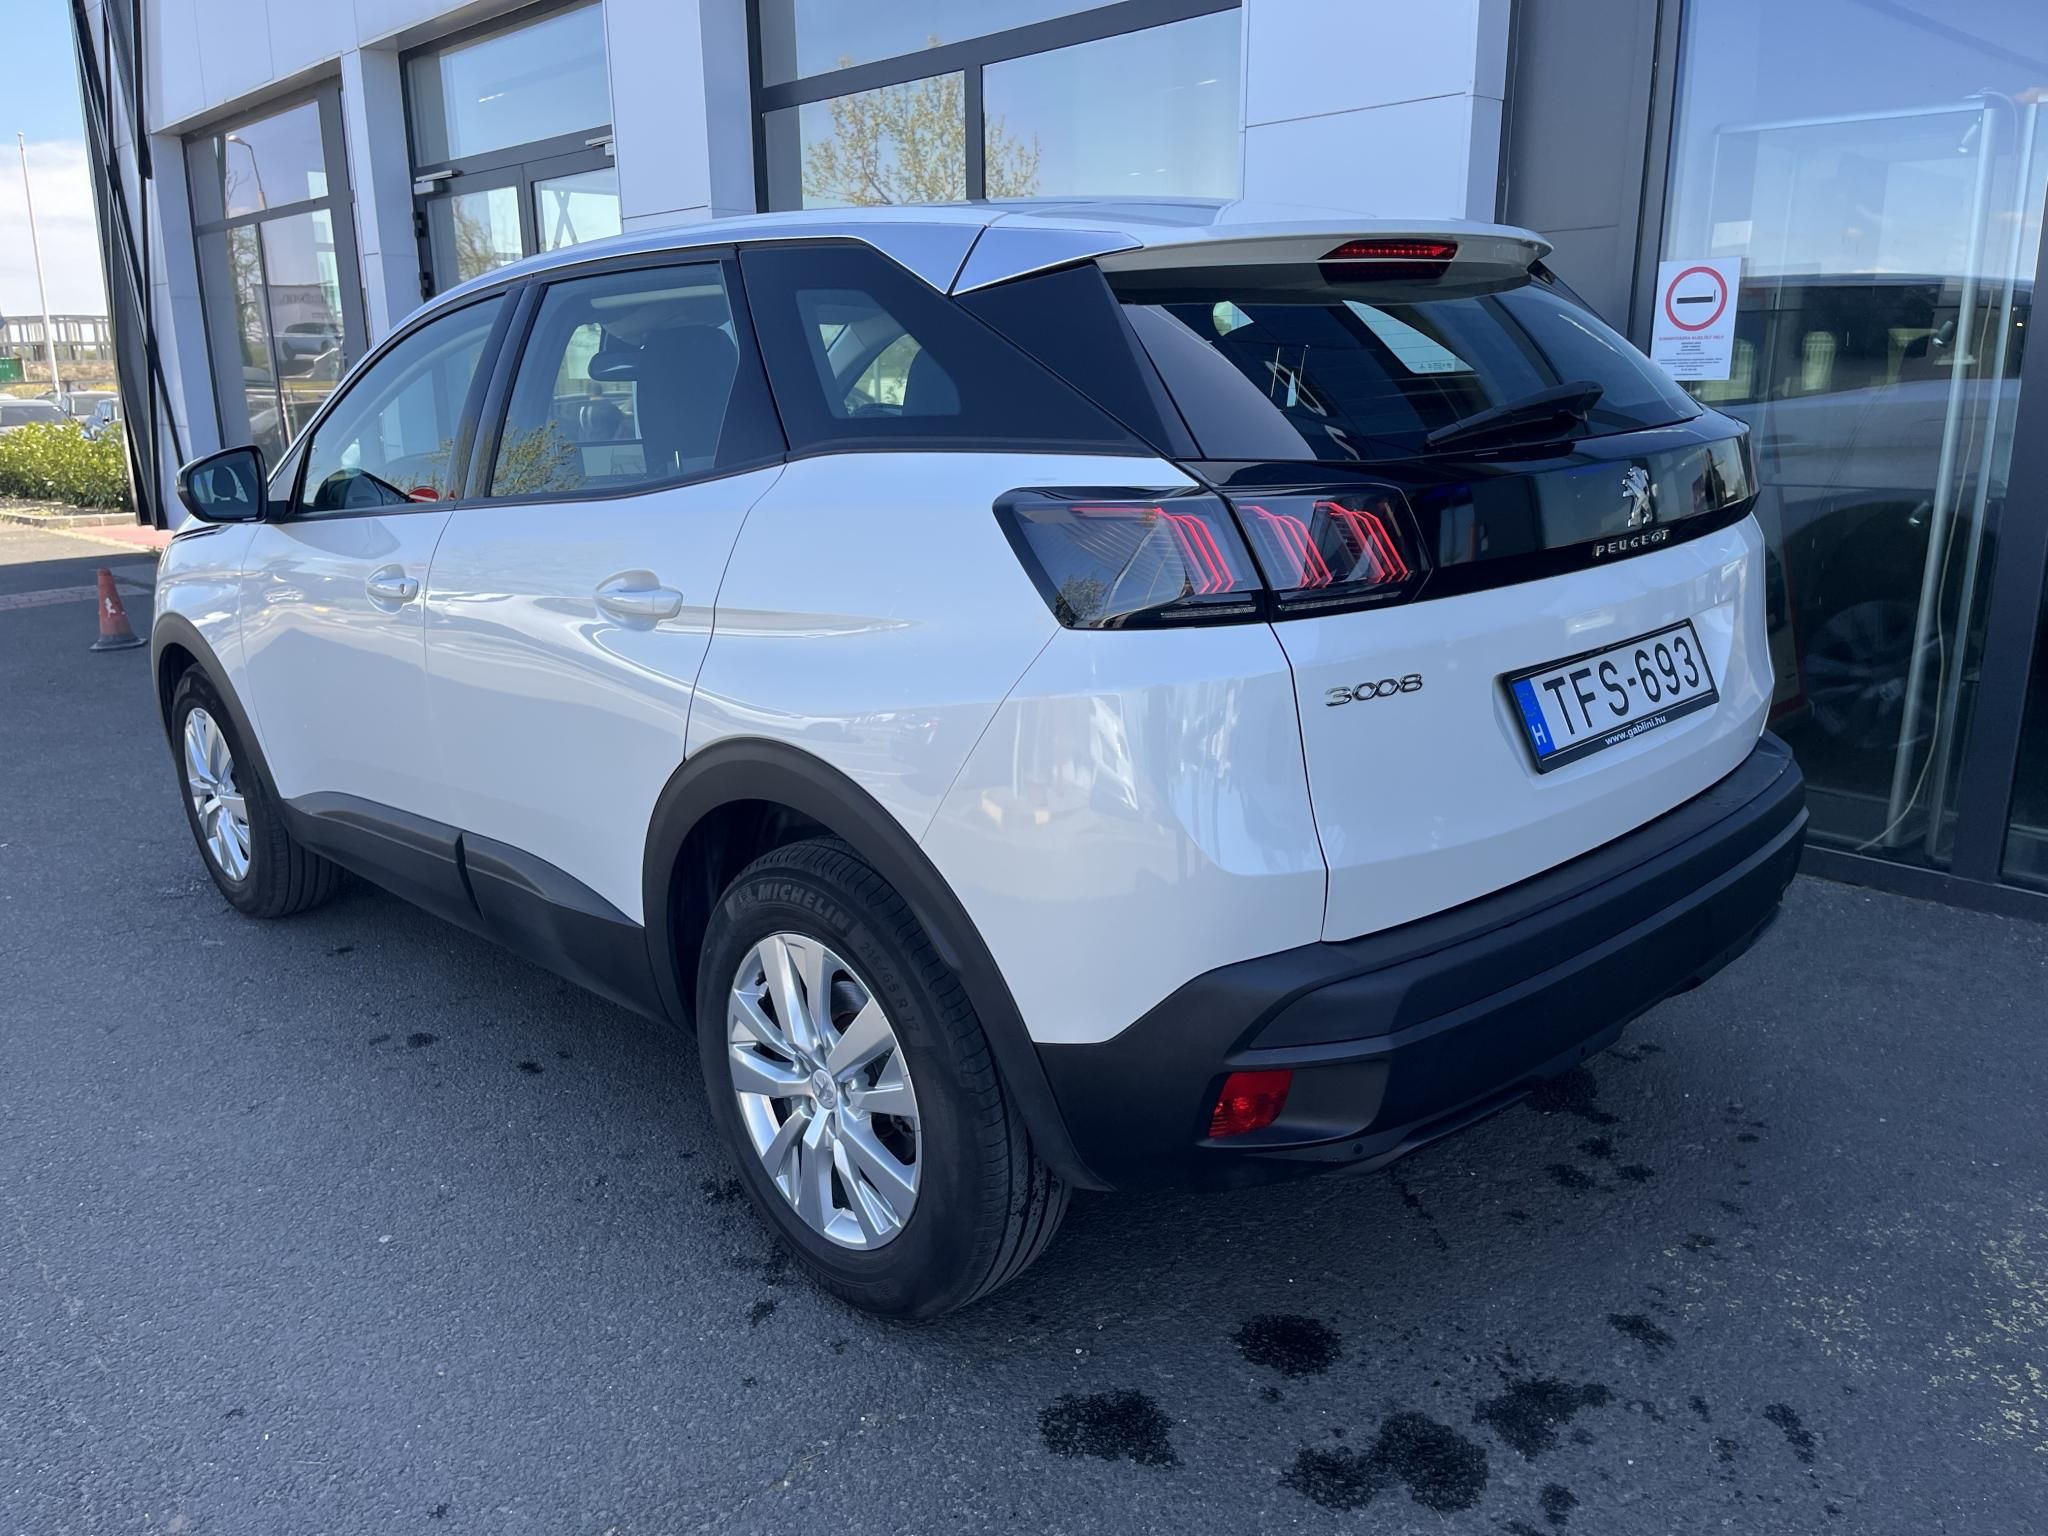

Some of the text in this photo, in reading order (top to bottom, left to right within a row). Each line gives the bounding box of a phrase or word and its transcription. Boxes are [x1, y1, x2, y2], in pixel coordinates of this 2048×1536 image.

[1595, 529, 1670, 557] PEUGEOT
[1325, 673, 1423, 707] 3008
[1542, 636, 1700, 736] TFS-693
[1531, 723, 1547, 746] H
[1605, 715, 1666, 745] www.gablini.hu
[758, 882, 851, 931] MICHELIN
